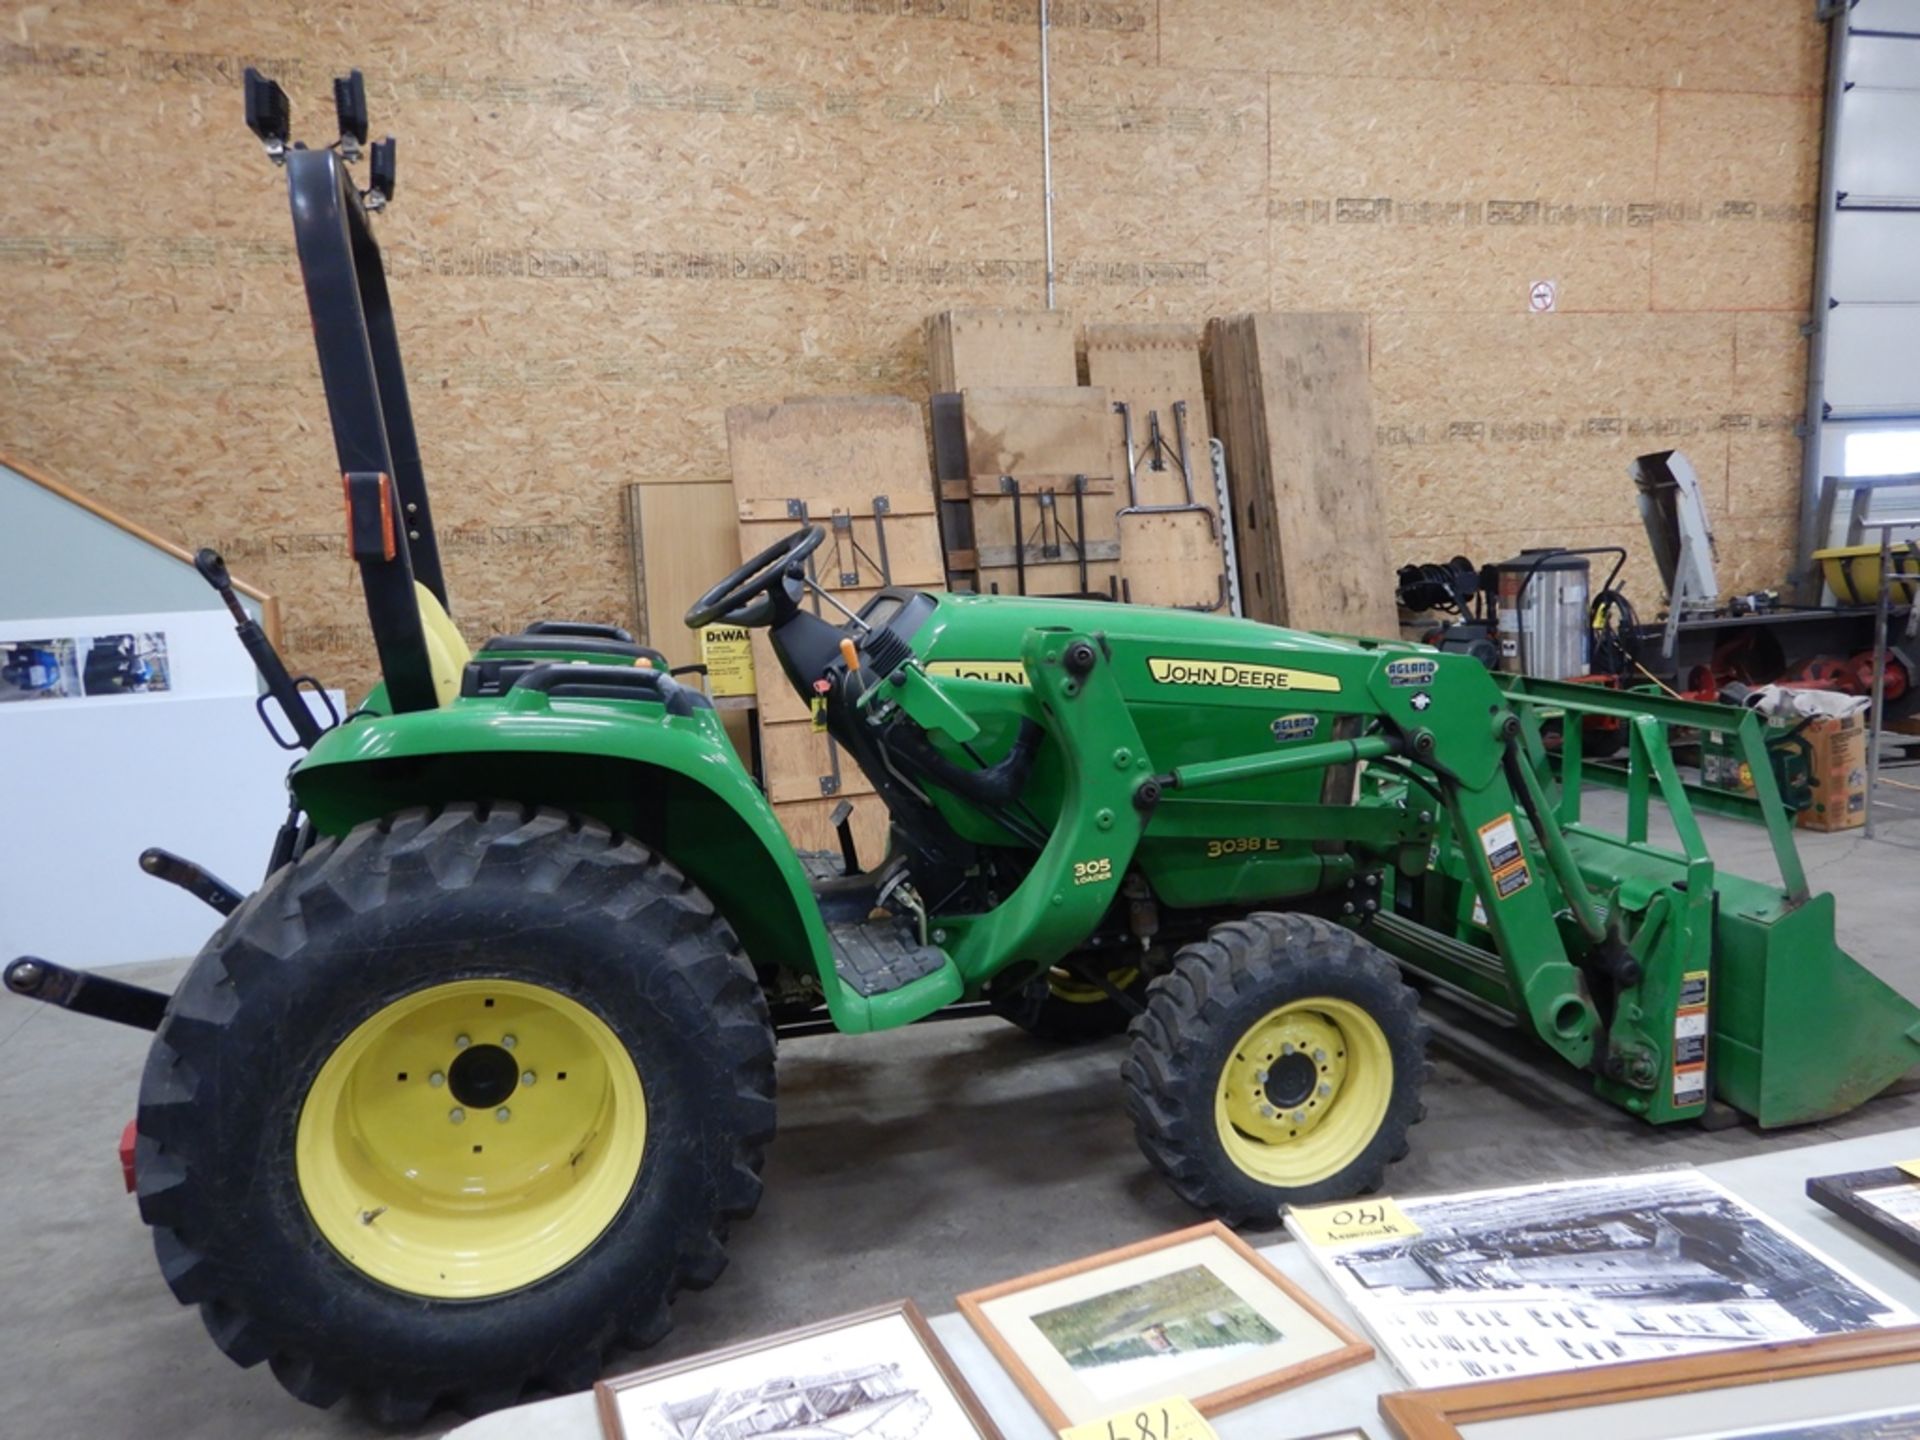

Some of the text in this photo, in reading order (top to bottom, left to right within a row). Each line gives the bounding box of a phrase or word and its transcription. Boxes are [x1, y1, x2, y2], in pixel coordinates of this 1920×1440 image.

[706, 629, 751, 643] DEWAL
[1159, 663, 1288, 687] JOHN DEERE
[1207, 837, 1261, 858] 3038
[1074, 858, 1111, 876] 305
[1074, 872, 1112, 886] LOADER
[1332, 1205, 1385, 1226] 190
